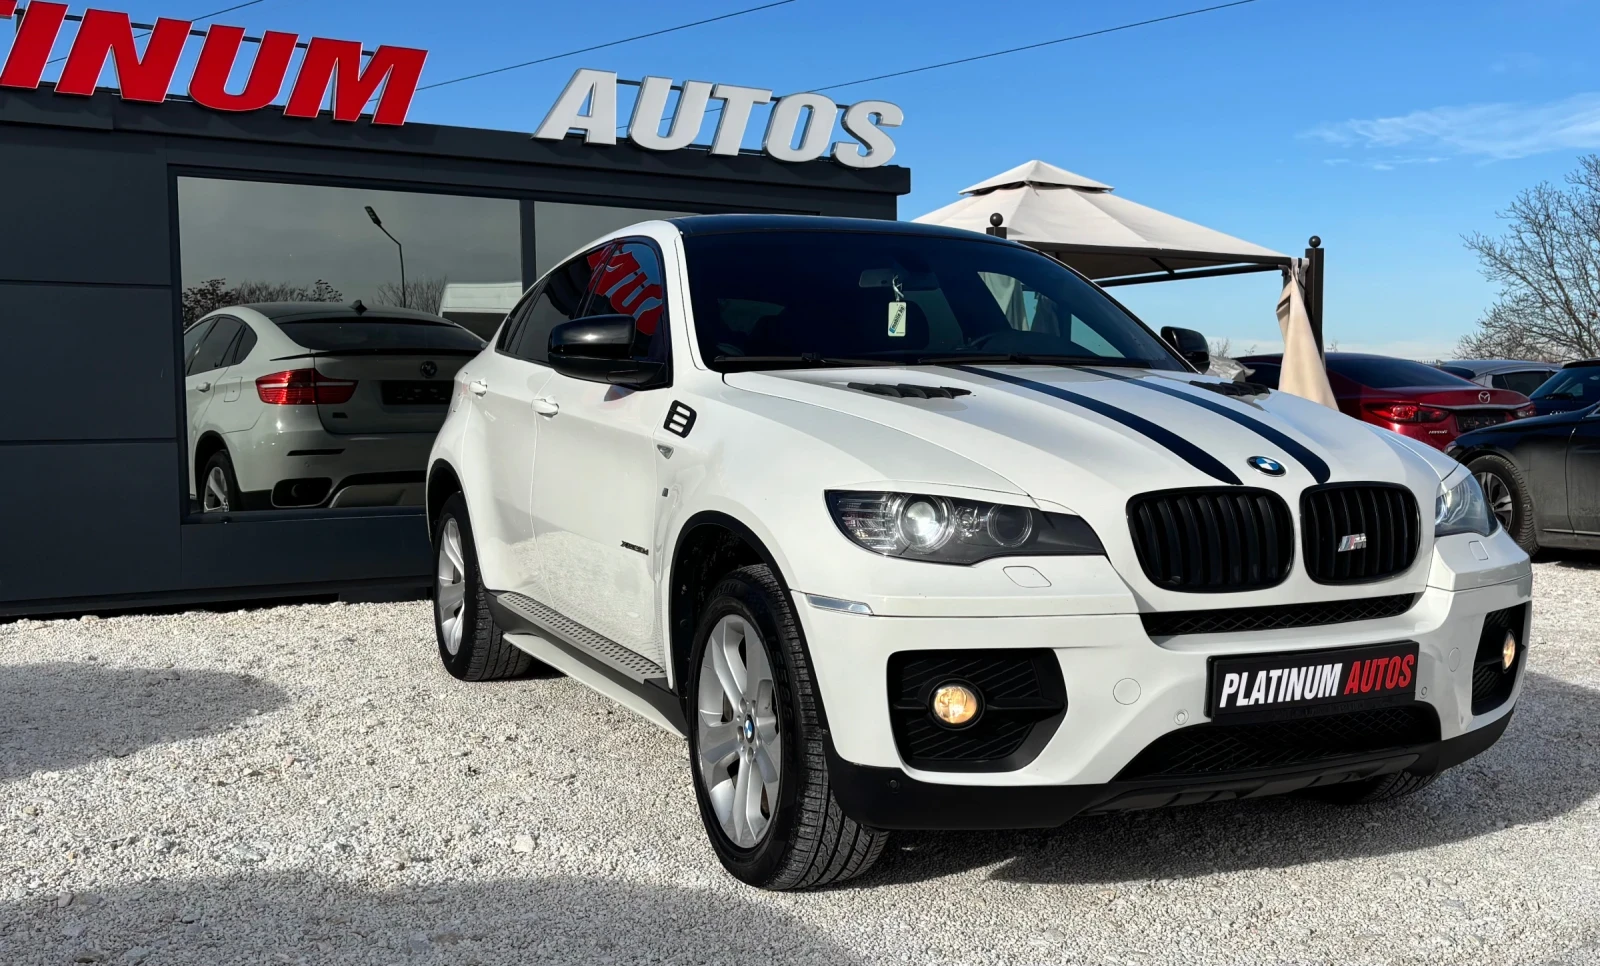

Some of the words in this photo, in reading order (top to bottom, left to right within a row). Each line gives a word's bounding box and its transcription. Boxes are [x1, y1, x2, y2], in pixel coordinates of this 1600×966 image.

[0, 0, 428, 126] INUM
[532, 68, 905, 169] AUTOS
[1218, 662, 1343, 709] PLATINUM
[1344, 653, 1416, 696] AUTOS
